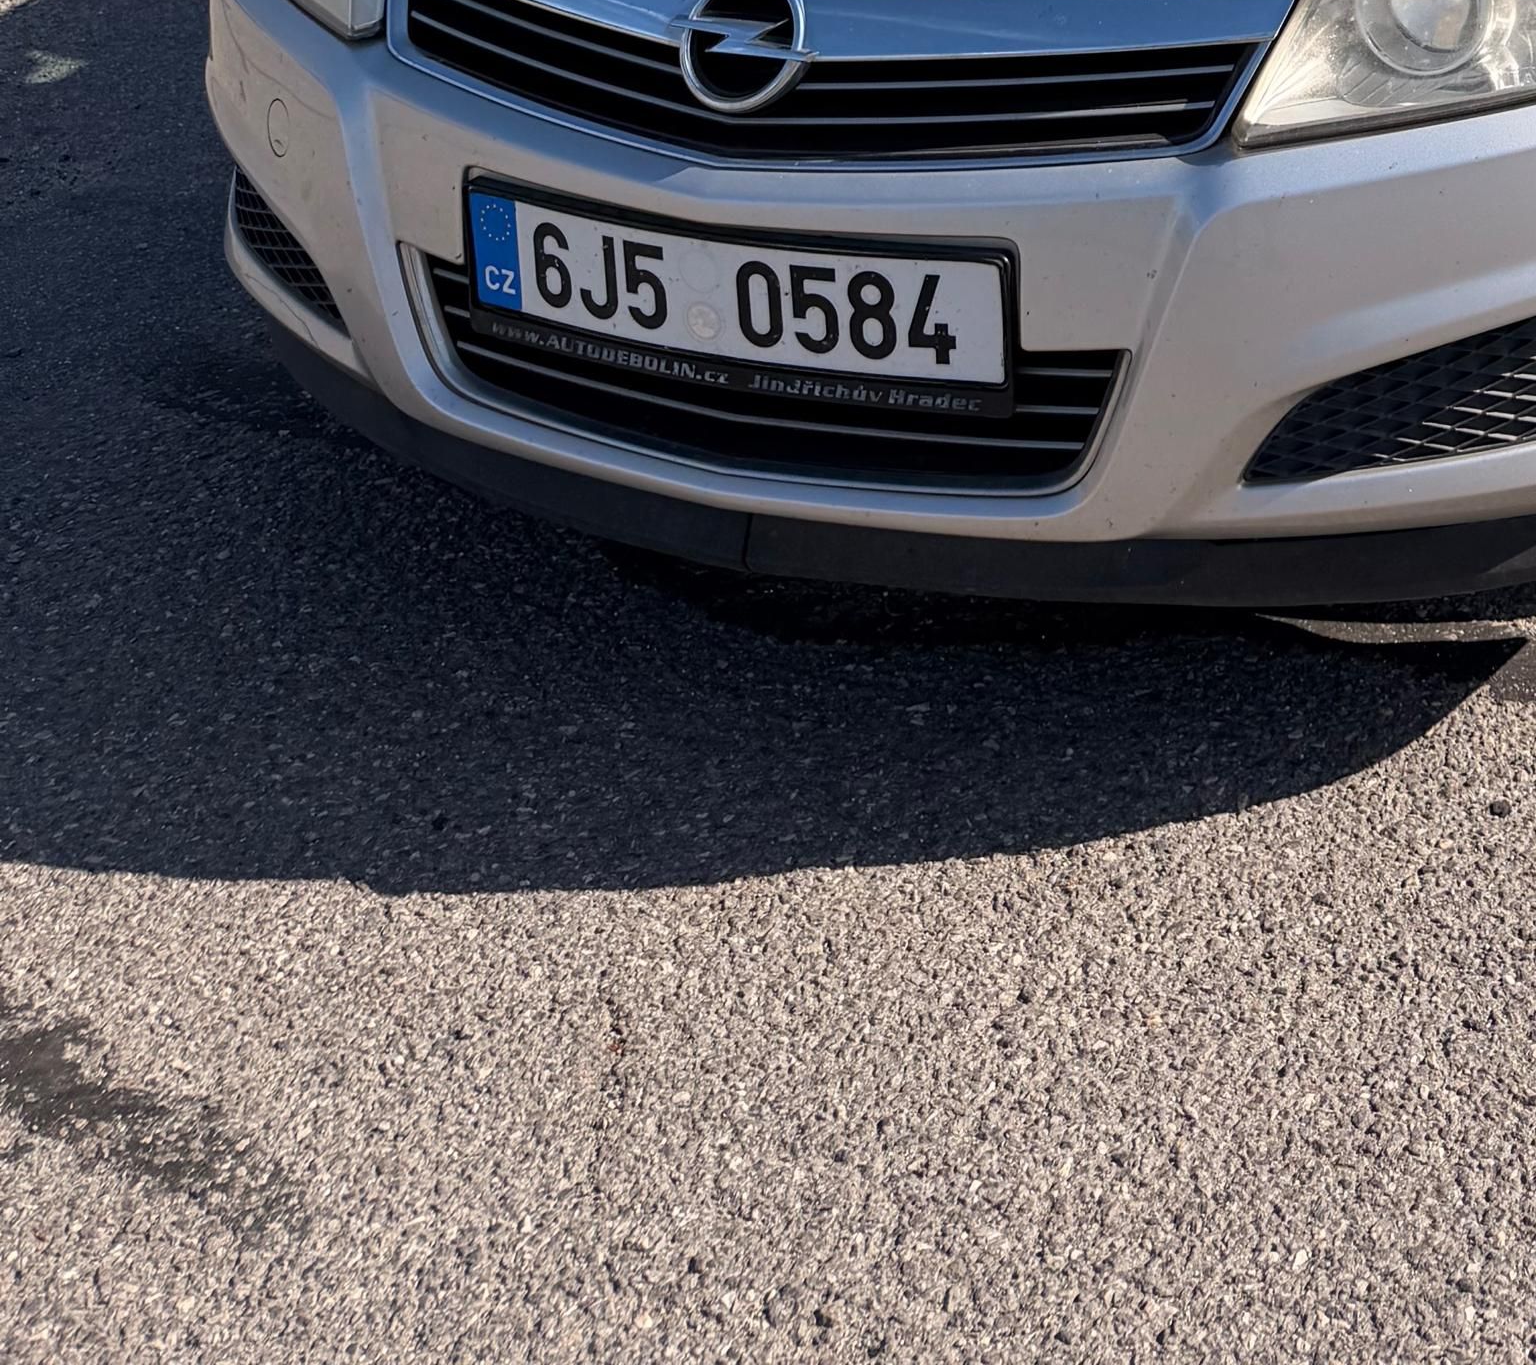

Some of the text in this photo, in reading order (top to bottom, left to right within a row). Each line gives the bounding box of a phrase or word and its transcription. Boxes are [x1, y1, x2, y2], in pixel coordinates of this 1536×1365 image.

[484, 265, 517, 295] CZ
[533, 222, 957, 365] 6J5 0584
[888, 388, 983, 412] Hradec
